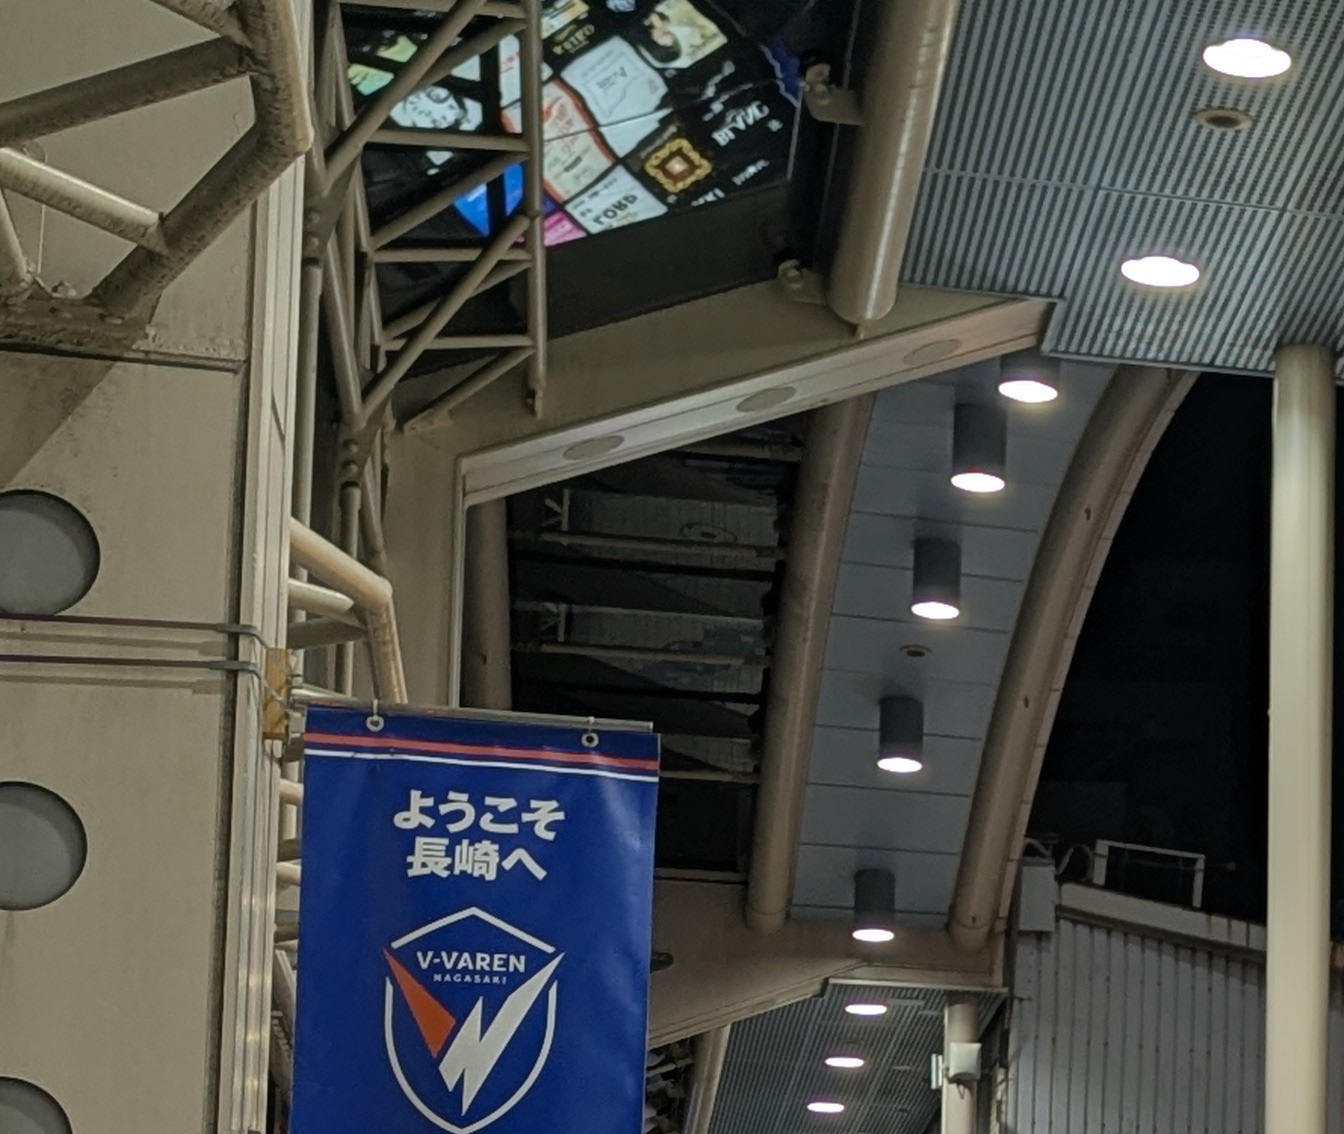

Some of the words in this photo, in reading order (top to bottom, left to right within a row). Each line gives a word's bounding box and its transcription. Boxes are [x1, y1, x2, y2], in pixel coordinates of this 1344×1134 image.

[393, 789, 565, 841] ようこそ
[406, 836, 547, 881] 長崎へ
[416, 951, 526, 973] V-VAREN
[433, 973, 507, 985] NAGASAKI
